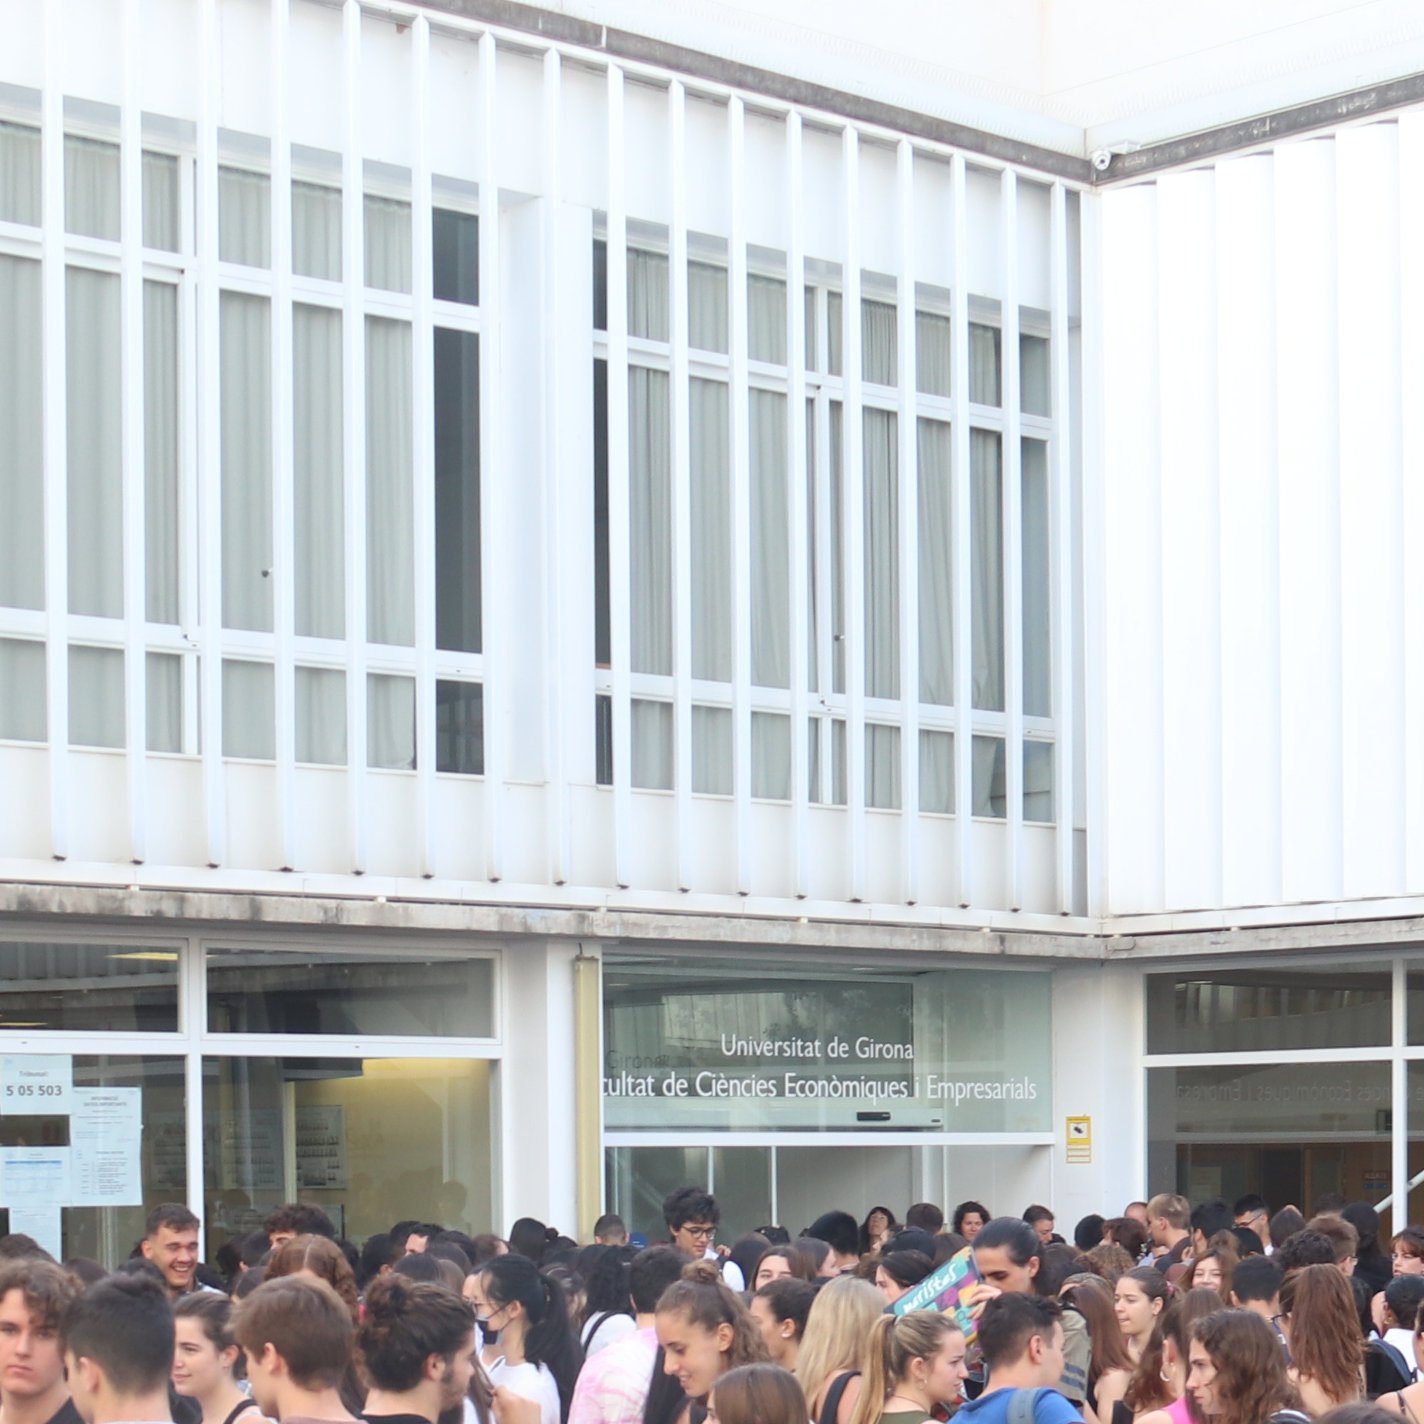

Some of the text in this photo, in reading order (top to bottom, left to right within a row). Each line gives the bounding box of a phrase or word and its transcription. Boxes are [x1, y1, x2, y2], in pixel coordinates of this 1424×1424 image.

[721, 1034, 915, 1060] Universitat de Girona
[6, 1084, 63, 1097] 5 05 503
[663, 1070, 689, 1097] de
[695, 1070, 777, 1098] Ciències
[784, 1073, 908, 1106] Econòmiques
[915, 1075, 920, 1099] i
[927, 1075, 1037, 1106] Empresarials
